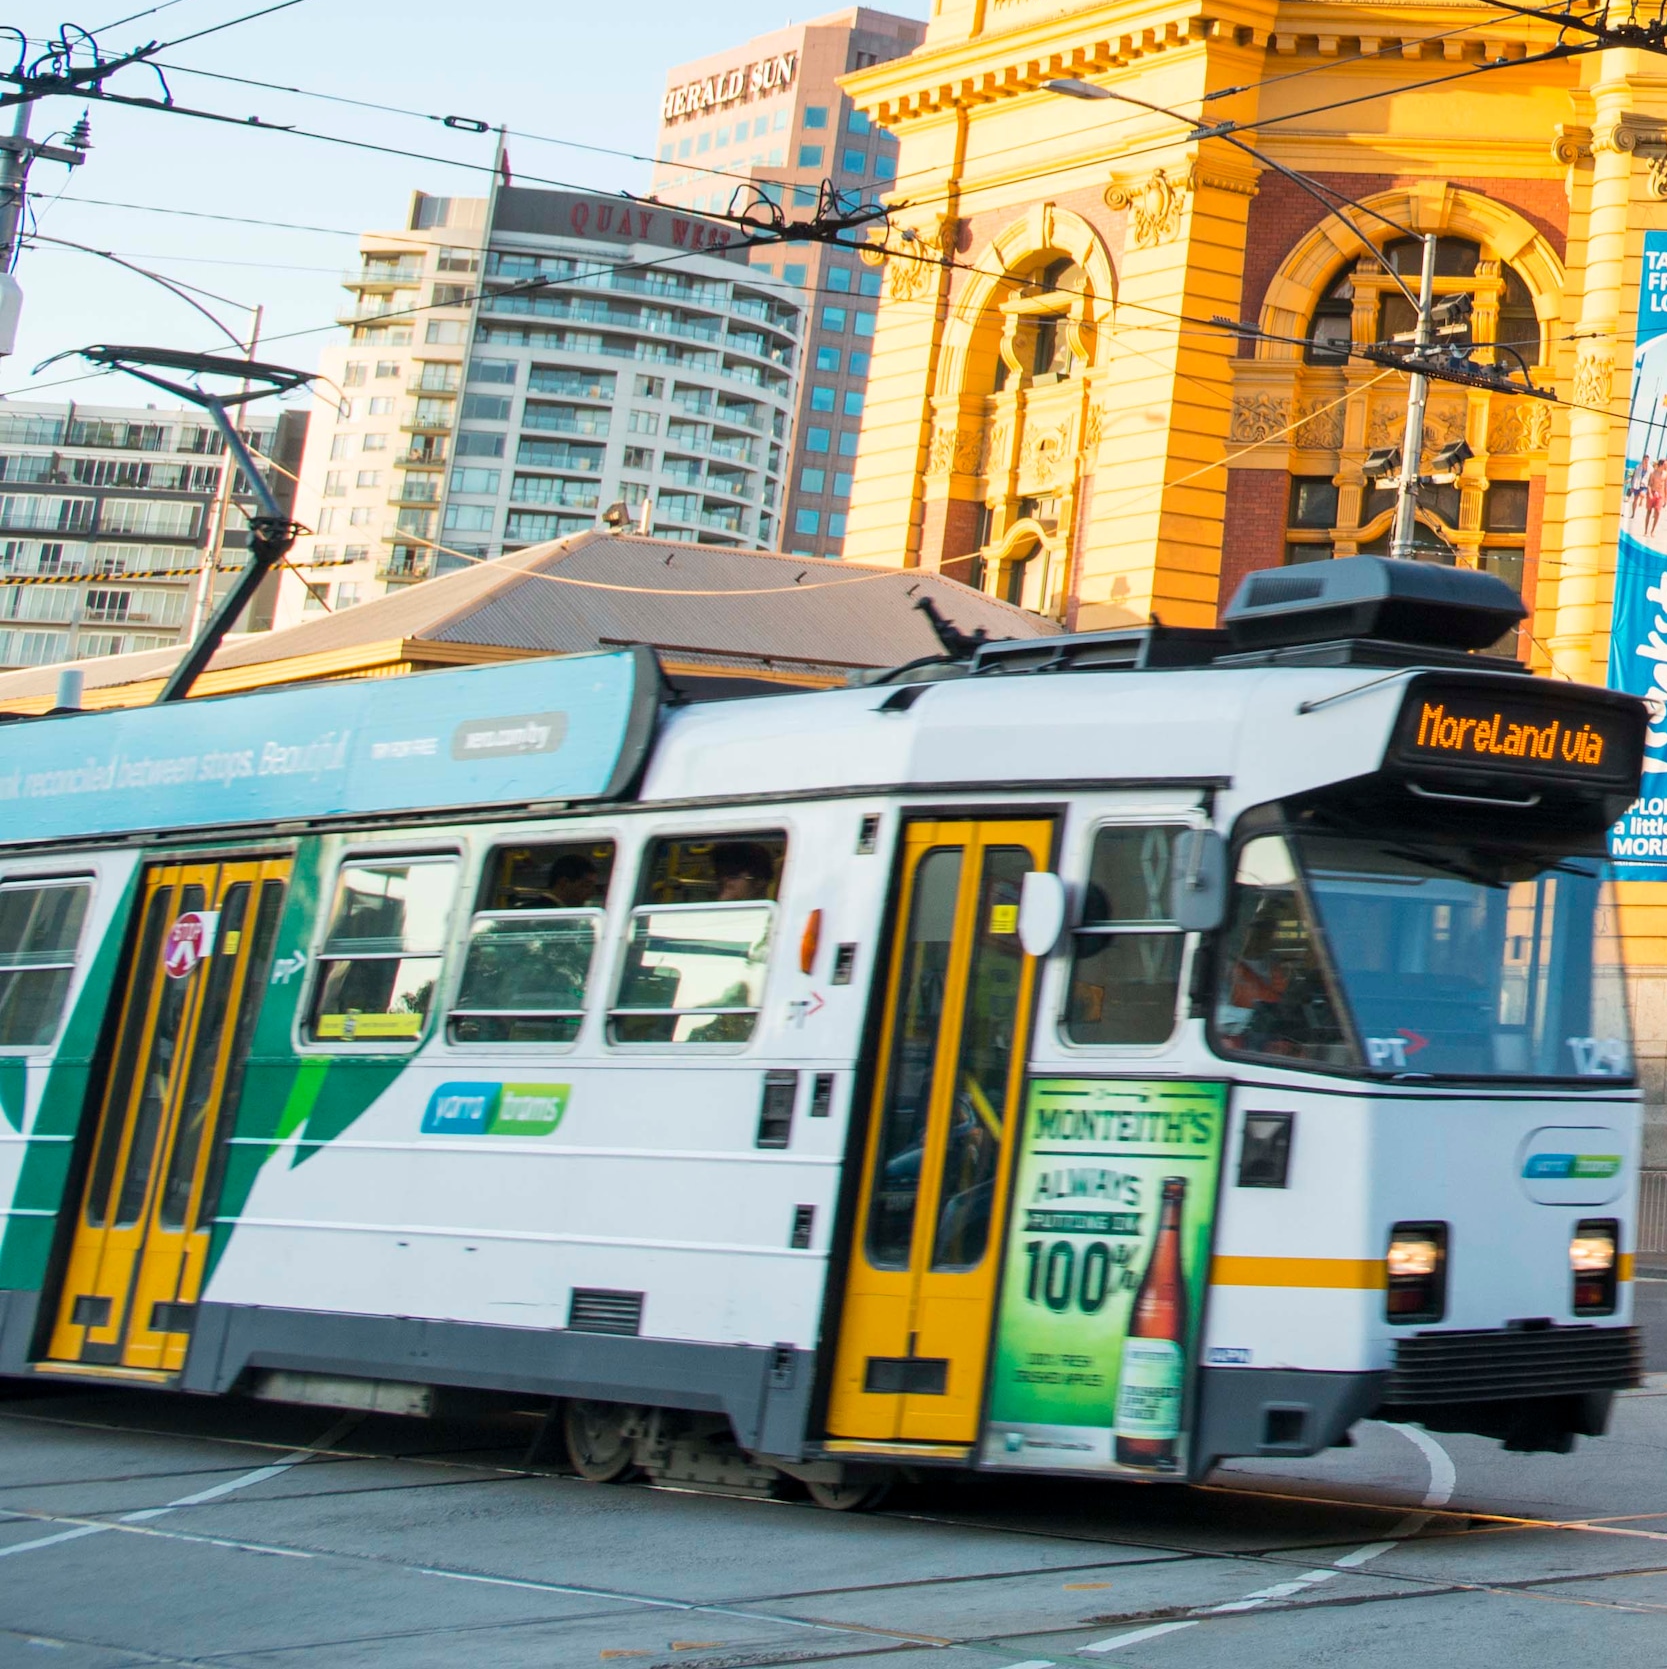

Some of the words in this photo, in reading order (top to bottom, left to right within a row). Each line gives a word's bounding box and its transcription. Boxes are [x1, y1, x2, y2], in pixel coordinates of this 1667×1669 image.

[662, 72, 745, 119] HERALD
[750, 55, 796, 93] SUN
[570, 202, 654, 239] QUAY
[672, 218, 731, 258] WEST
[1417, 703, 1559, 760] Moreland
[1561, 724, 1604, 765] via
[1613, 820, 1626, 835] a
[173, 922, 203, 941] STOP
[1365, 1036, 1409, 1067] PT
[432, 1095, 486, 1127] yarra
[501, 1091, 561, 1122] trams
[1034, 1108, 1213, 1145] MONTEITH'S
[1032, 1167, 1143, 1206] ALWAYS
